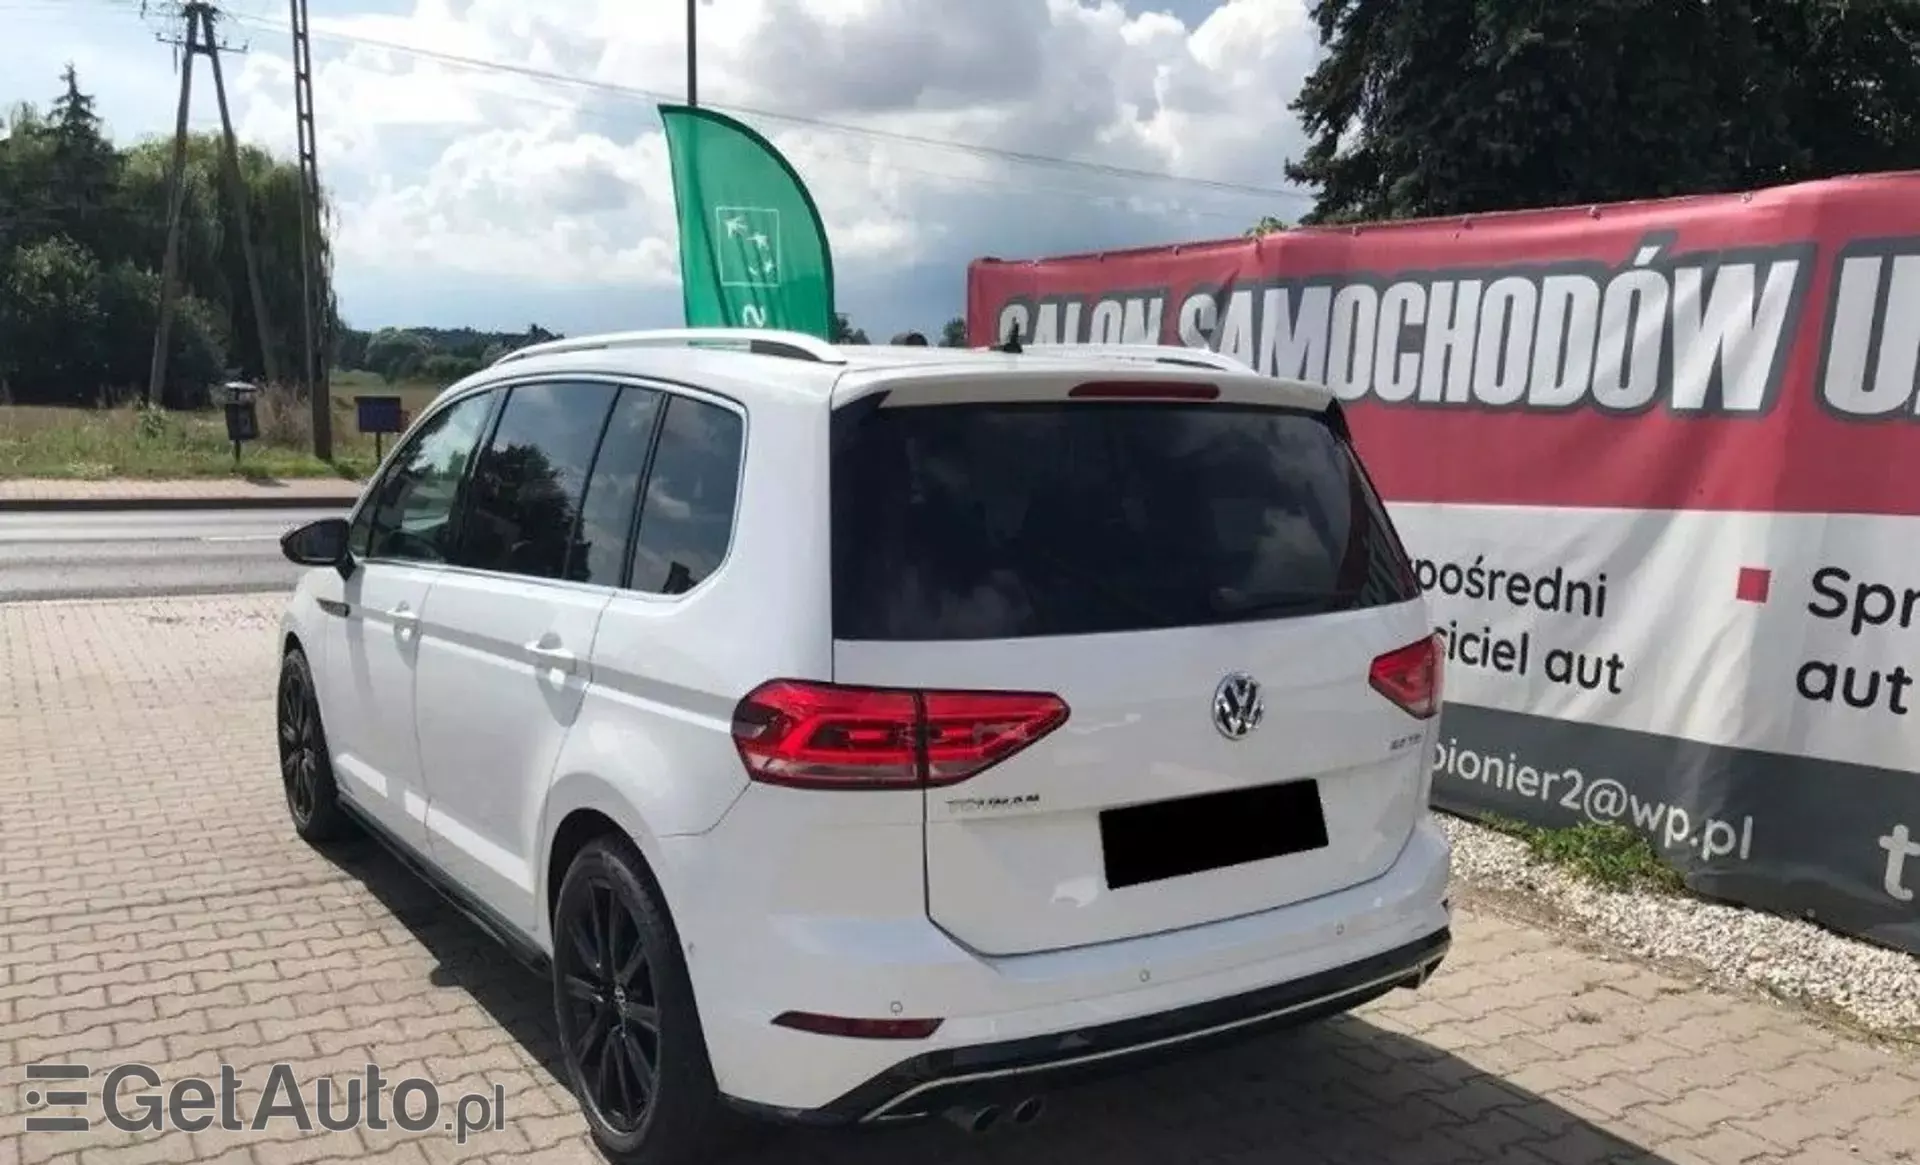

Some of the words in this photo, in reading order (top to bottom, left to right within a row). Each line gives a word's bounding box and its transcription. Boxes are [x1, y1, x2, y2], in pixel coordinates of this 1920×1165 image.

[1180, 245, 1801, 411] SAMOCHODÓW
[1823, 254, 1920, 415] U
[1408, 554, 1608, 618] pośredni
[1434, 619, 1531, 676] iciel
[1544, 652, 1625, 695] aut
[1796, 660, 1914, 715] aut
